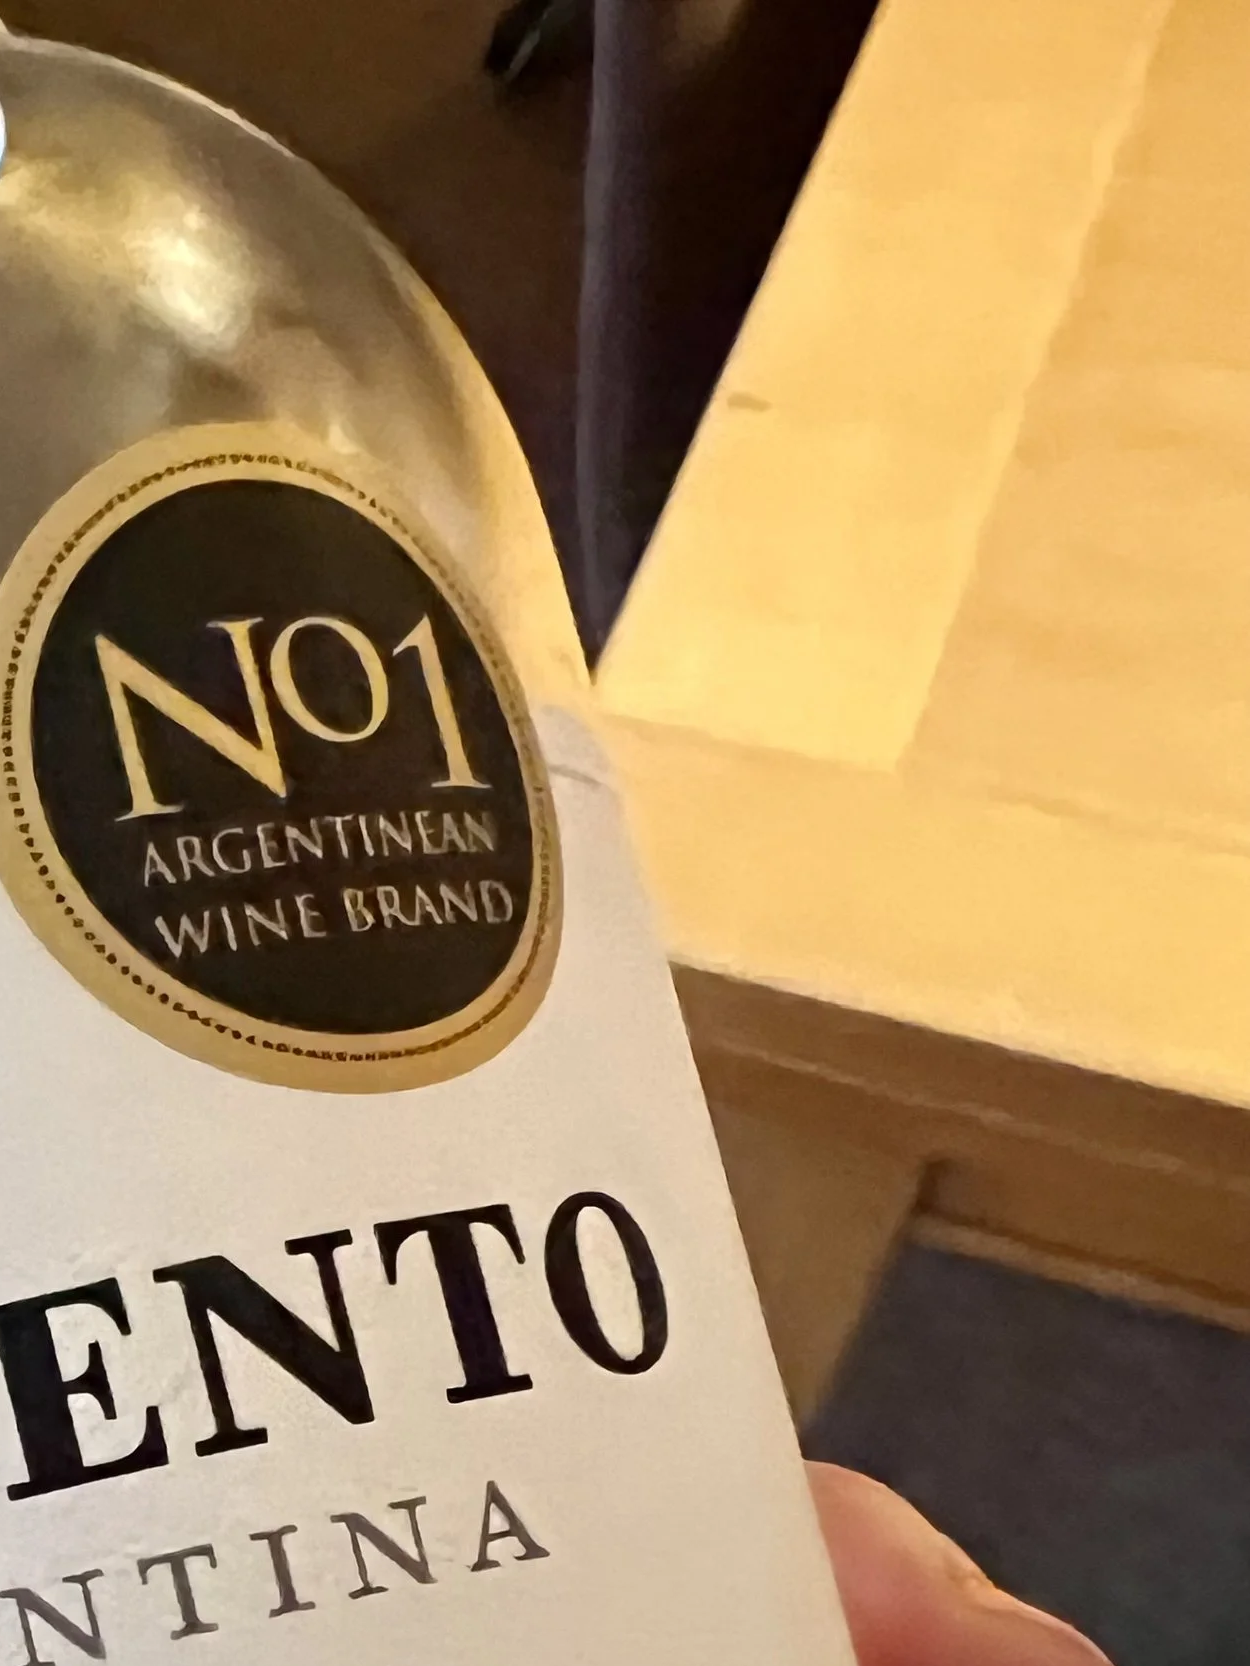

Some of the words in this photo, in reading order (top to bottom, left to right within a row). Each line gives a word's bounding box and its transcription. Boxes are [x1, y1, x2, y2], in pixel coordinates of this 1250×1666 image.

[143, 808, 498, 888] ARGENTINEAN
[154, 892, 328, 959] WINE
[344, 879, 514, 934] BRAND
